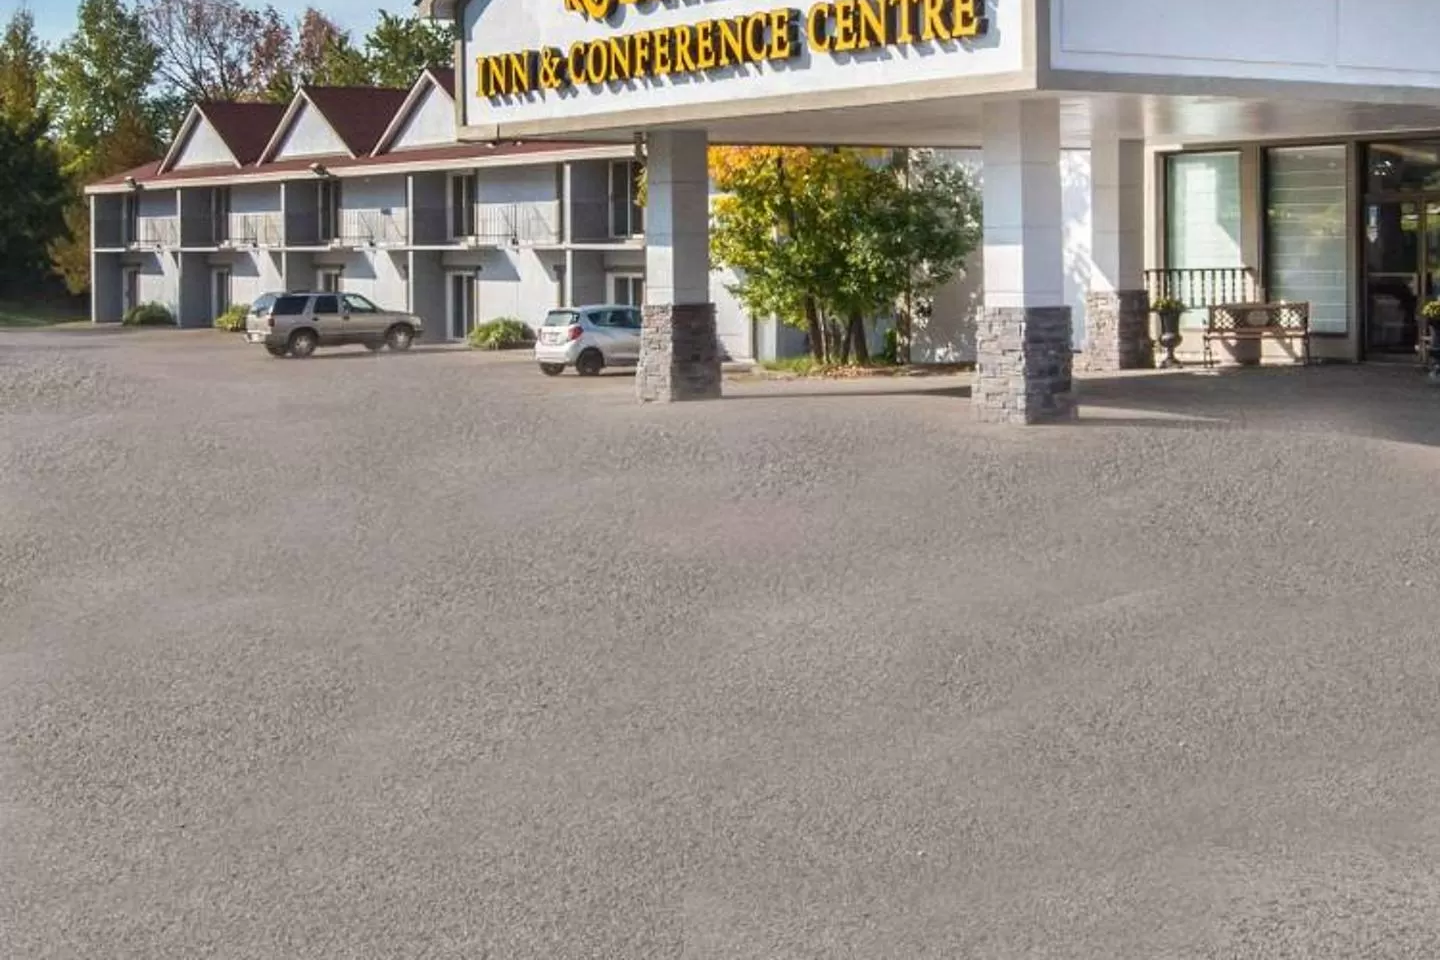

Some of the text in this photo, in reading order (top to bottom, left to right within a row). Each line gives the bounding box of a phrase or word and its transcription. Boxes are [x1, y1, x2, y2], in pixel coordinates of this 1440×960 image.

[476, 52, 532, 98] INN
[540, 46, 563, 88] &
[568, 9, 796, 85] CONFERENCE
